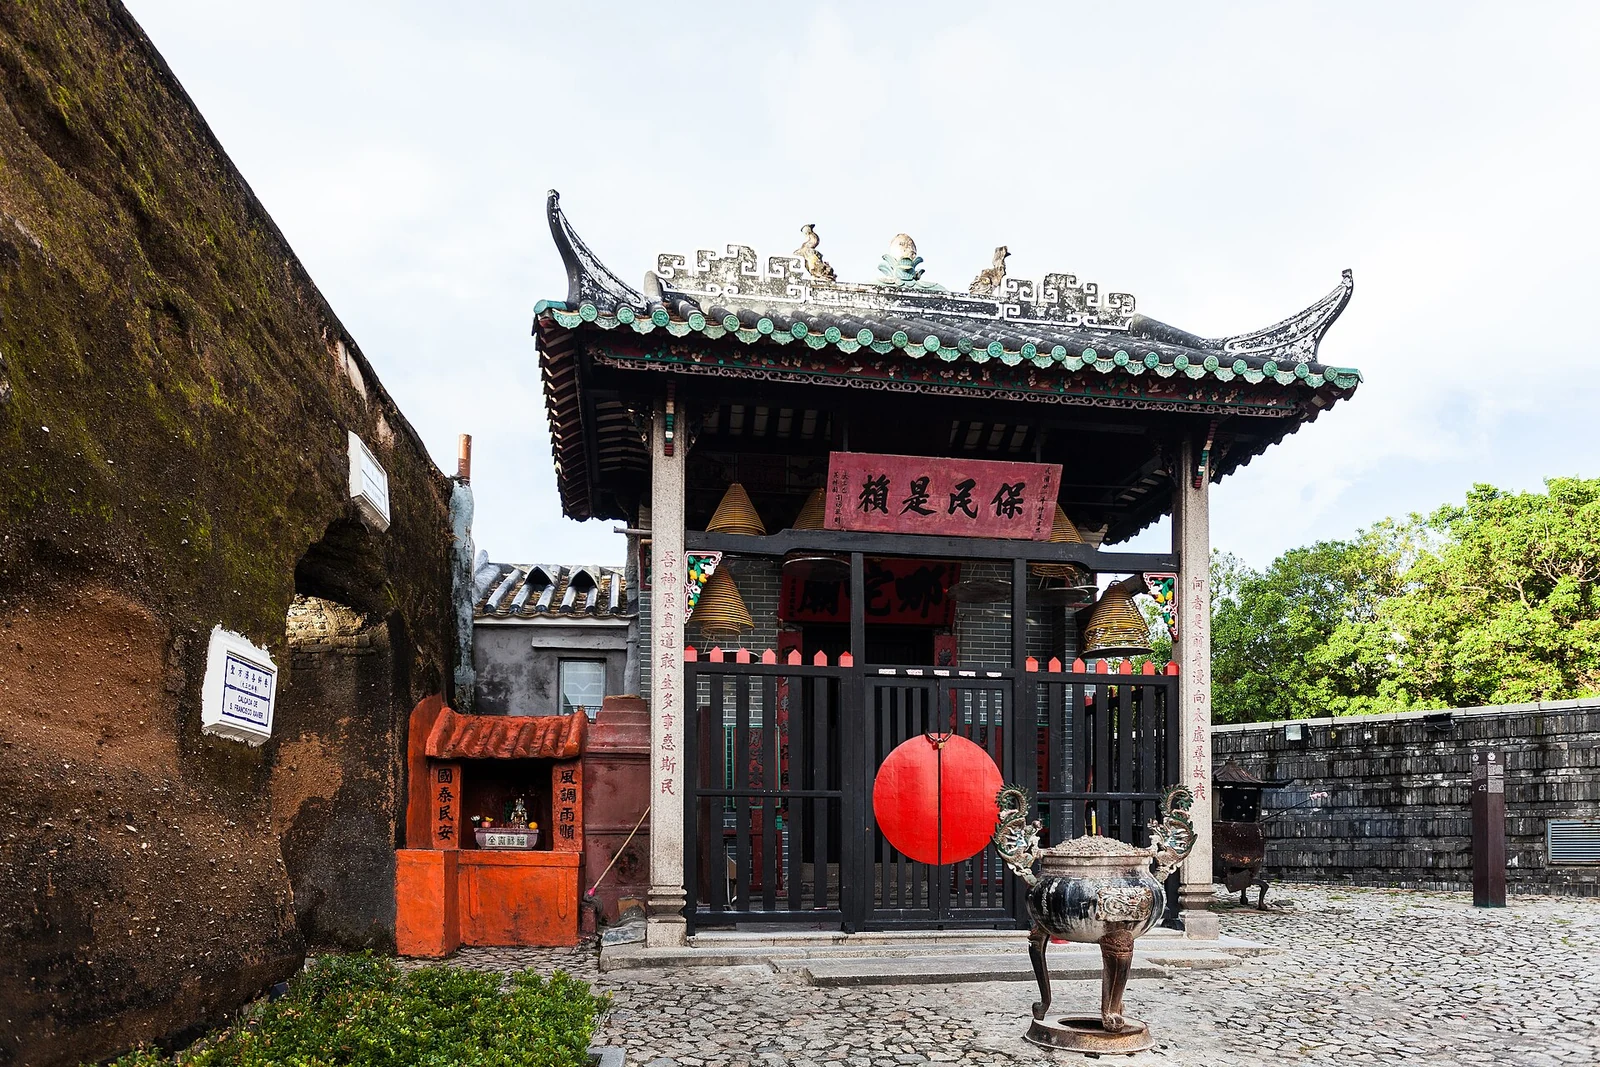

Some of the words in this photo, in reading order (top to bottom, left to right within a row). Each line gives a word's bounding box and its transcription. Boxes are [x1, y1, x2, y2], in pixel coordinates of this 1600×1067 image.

[234, 704, 252, 715] FRANCISCO
[253, 710, 263, 718] XAVIER
[253, 700, 258, 708] DE
[437, 768, 454, 841] 國泰民安
[559, 769, 578, 840] 風調雨順
